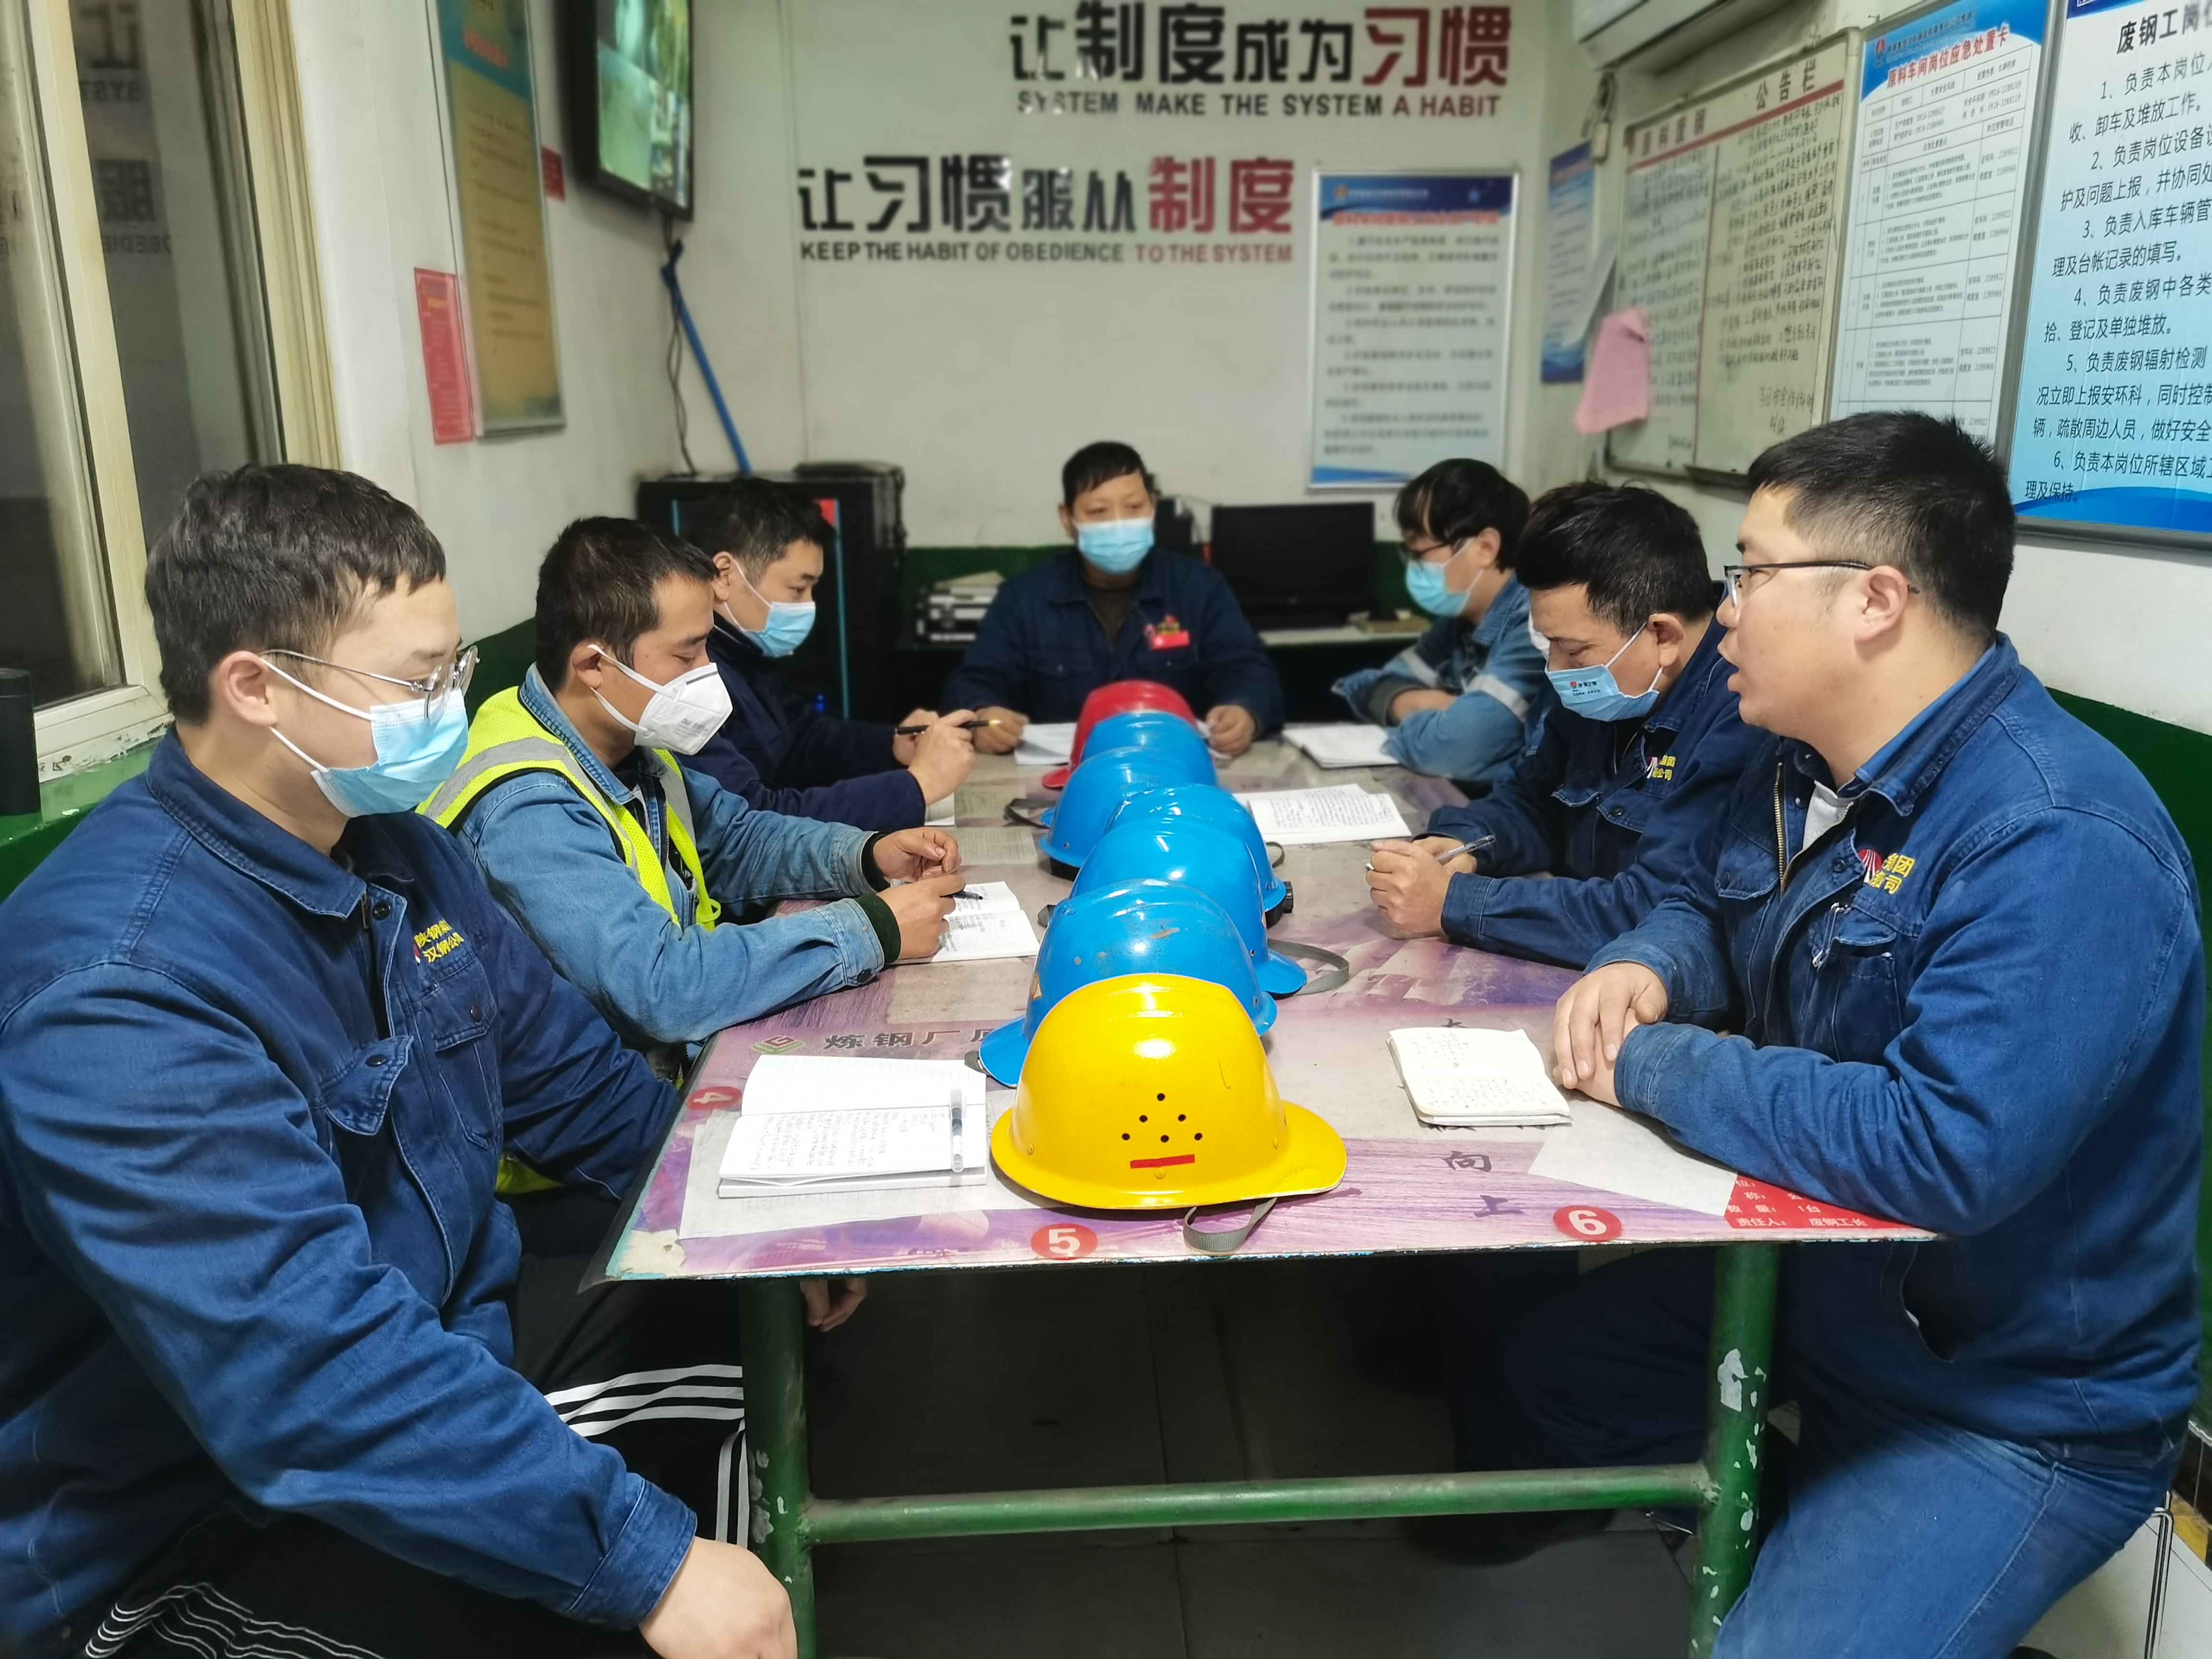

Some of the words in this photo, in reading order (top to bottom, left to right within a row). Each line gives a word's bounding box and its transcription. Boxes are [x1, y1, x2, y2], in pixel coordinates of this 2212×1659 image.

[1010, 0, 1511, 87] 让制度成为习惯
[1887, 23, 2010, 89] 原料车间岗位应急处置卡
[1756, 57, 1817, 111] 公告栏
[2101, 51, 2212, 99] 1、负责本岗位
[1018, 91, 1118, 114] SYSTEM
[1136, 92, 1205, 115] MAKE
[1222, 93, 1268, 116] THE
[1284, 94, 1382, 116] SYSTEM
[1394, 95, 1410, 116] A
[1421, 95, 1501, 117] HABIT
[2069, 91, 2200, 144] 收、卸车及堆放工作。
[798, 154, 1294, 233] 让习惯服从制度
[801, 242, 860, 261] KEEP
[866, 242, 902, 261] THE
[907, 242, 970, 262] HABIT
[976, 243, 1000, 261] OF
[1007, 243, 1124, 262] OBEDIENCE
[1136, 244, 1164, 263] TO
[1169, 244, 1208, 262] THE
[1213, 244, 1292, 262] SYSTEM
[2073, 272, 2212, 306] 4、负责废钢中各类
[2044, 313, 2171, 343] 拾、登记及单独堆放。
[2066, 345, 2208, 374] 5、负责废钢辐射检测
[2032, 418, 2212, 442] 辆，疏散周边人员，做好安全
[2024, 481, 2079, 503] 理及保持。
[1568, 1210, 1607, 1235] 6
[1809, 1217, 1868, 1227] 废钢工长
[1048, 1228, 1080, 1254] 5
